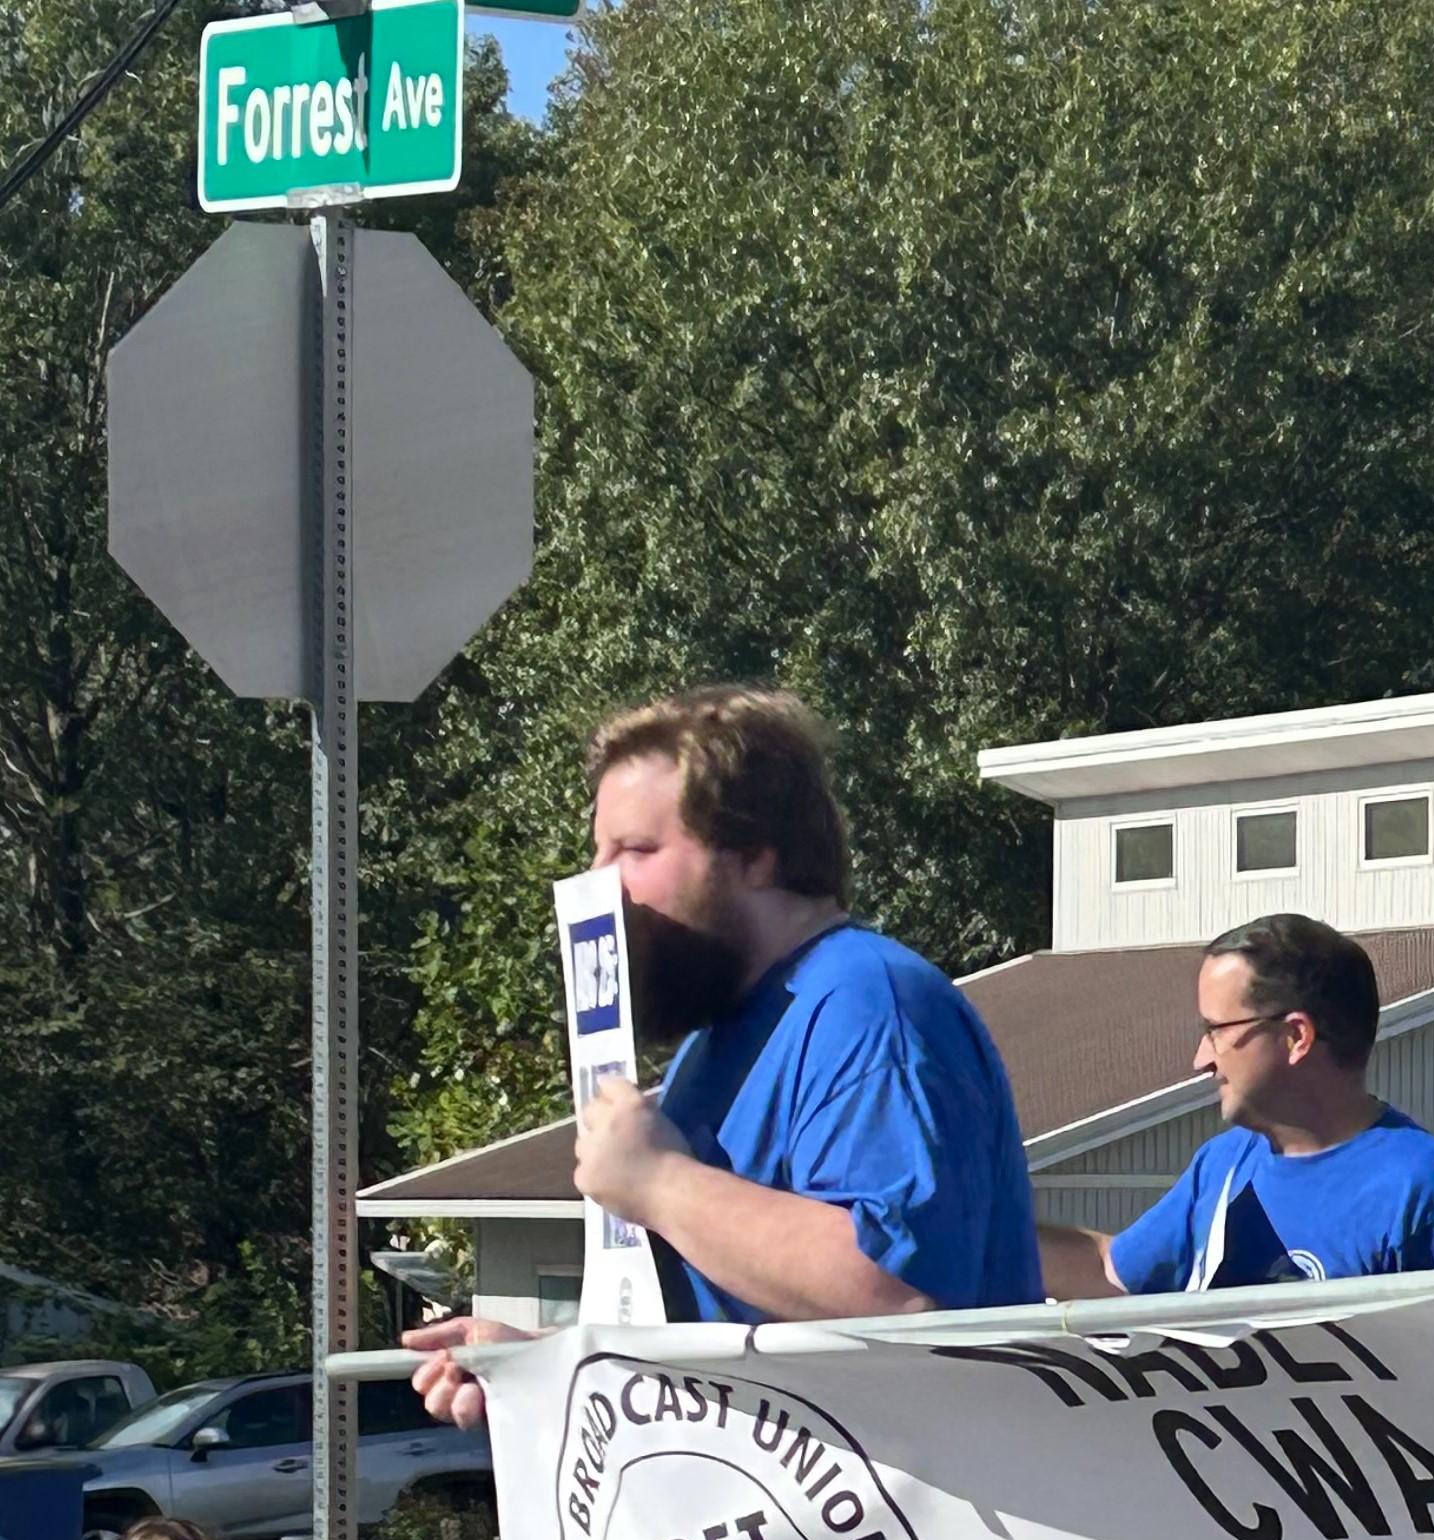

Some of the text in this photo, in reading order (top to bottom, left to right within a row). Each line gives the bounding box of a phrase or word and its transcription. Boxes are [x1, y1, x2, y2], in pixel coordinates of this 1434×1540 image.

[215, 52, 445, 166] Forrest Ave
[567, 1373, 735, 1537] BROADCAST
